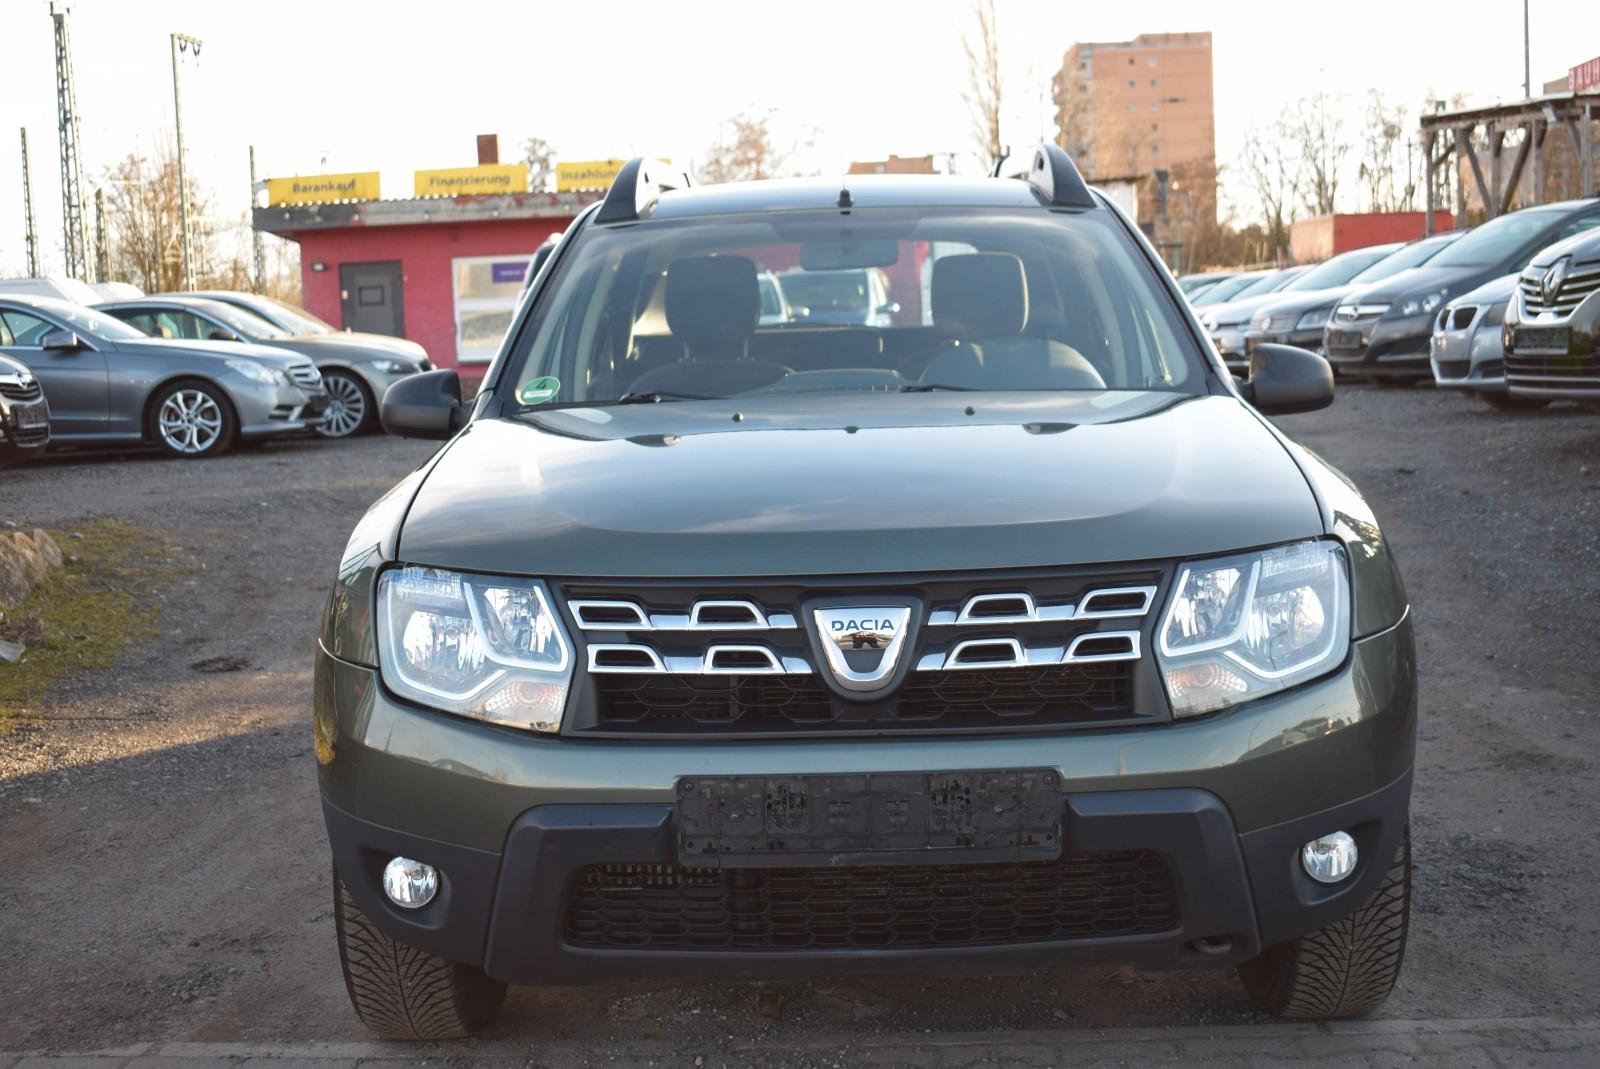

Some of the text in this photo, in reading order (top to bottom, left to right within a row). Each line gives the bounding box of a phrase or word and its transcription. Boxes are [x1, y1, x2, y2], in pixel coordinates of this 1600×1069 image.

[292, 178, 356, 193] Barankauf
[429, 175, 511, 187] Finanzierung
[536, 378, 546, 390] 4
[831, 619, 895, 632] DACIA
